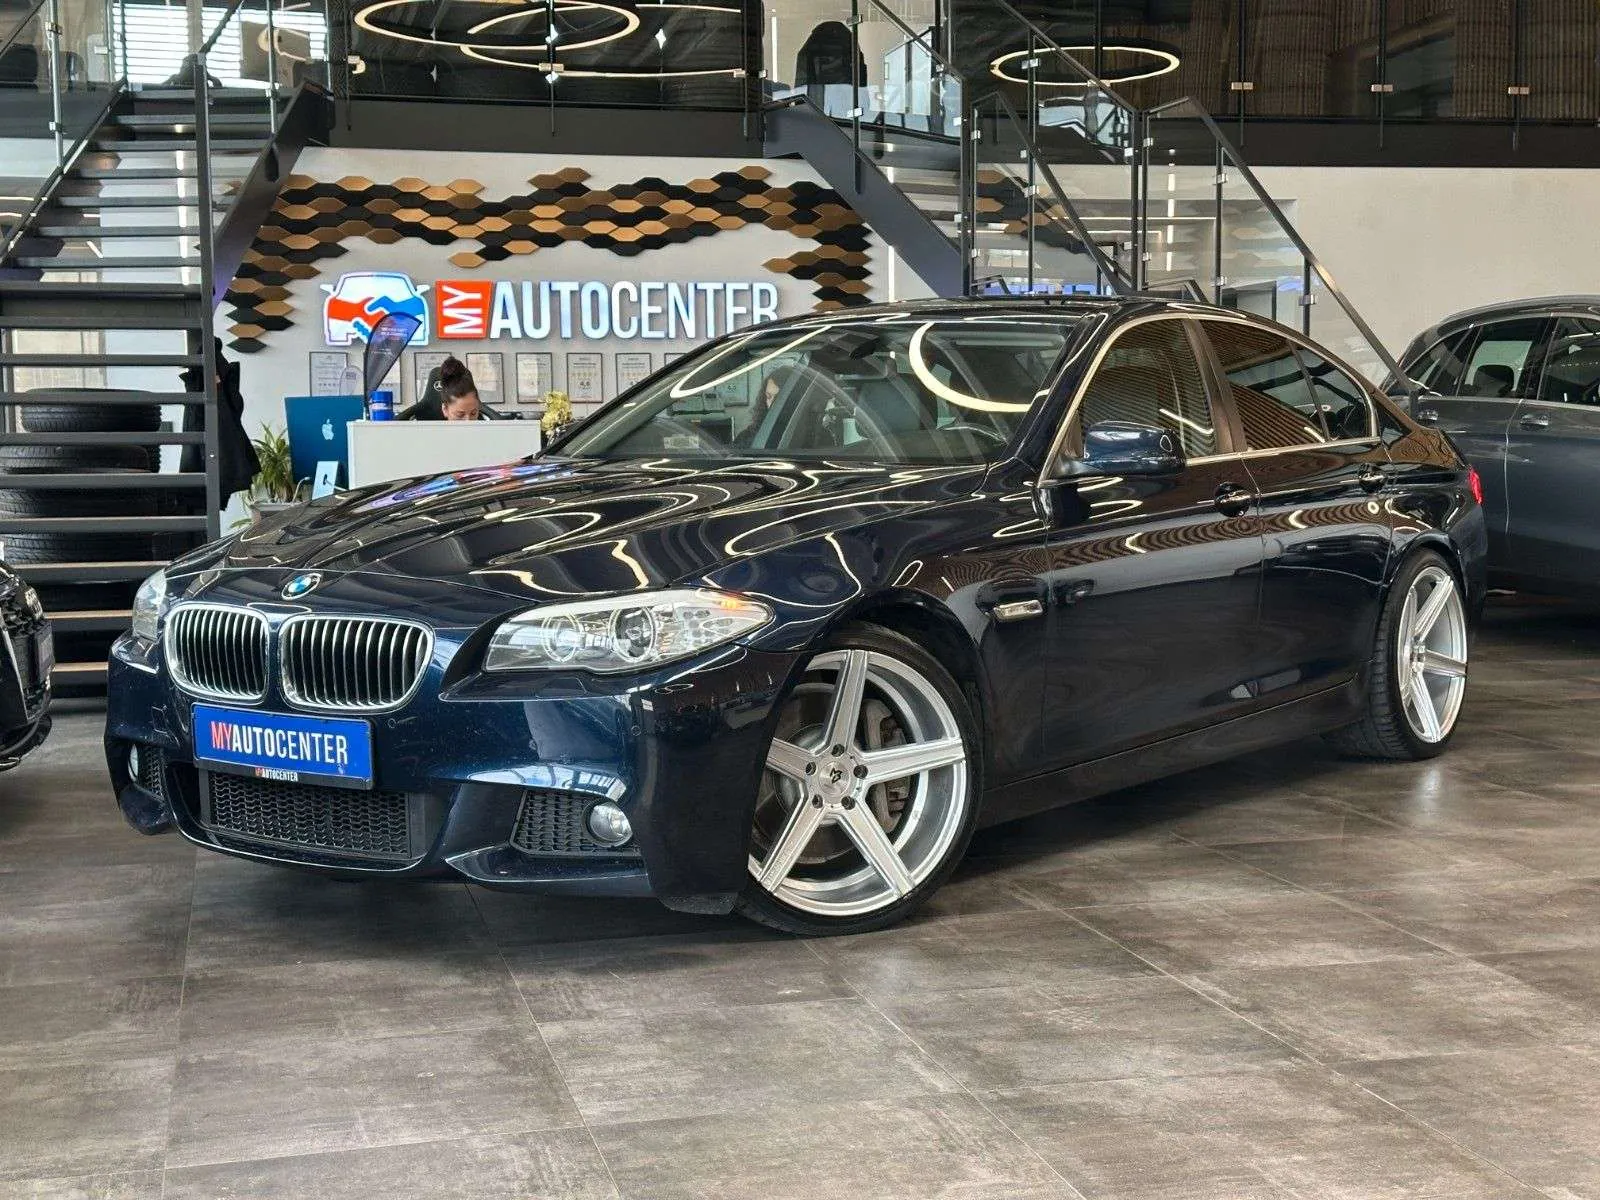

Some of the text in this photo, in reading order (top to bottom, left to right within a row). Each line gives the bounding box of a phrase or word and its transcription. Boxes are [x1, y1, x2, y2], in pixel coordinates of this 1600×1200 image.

[441, 281, 778, 339] MY AUTOCENTER
[210, 720, 348, 764] MYAUTOCENTER
